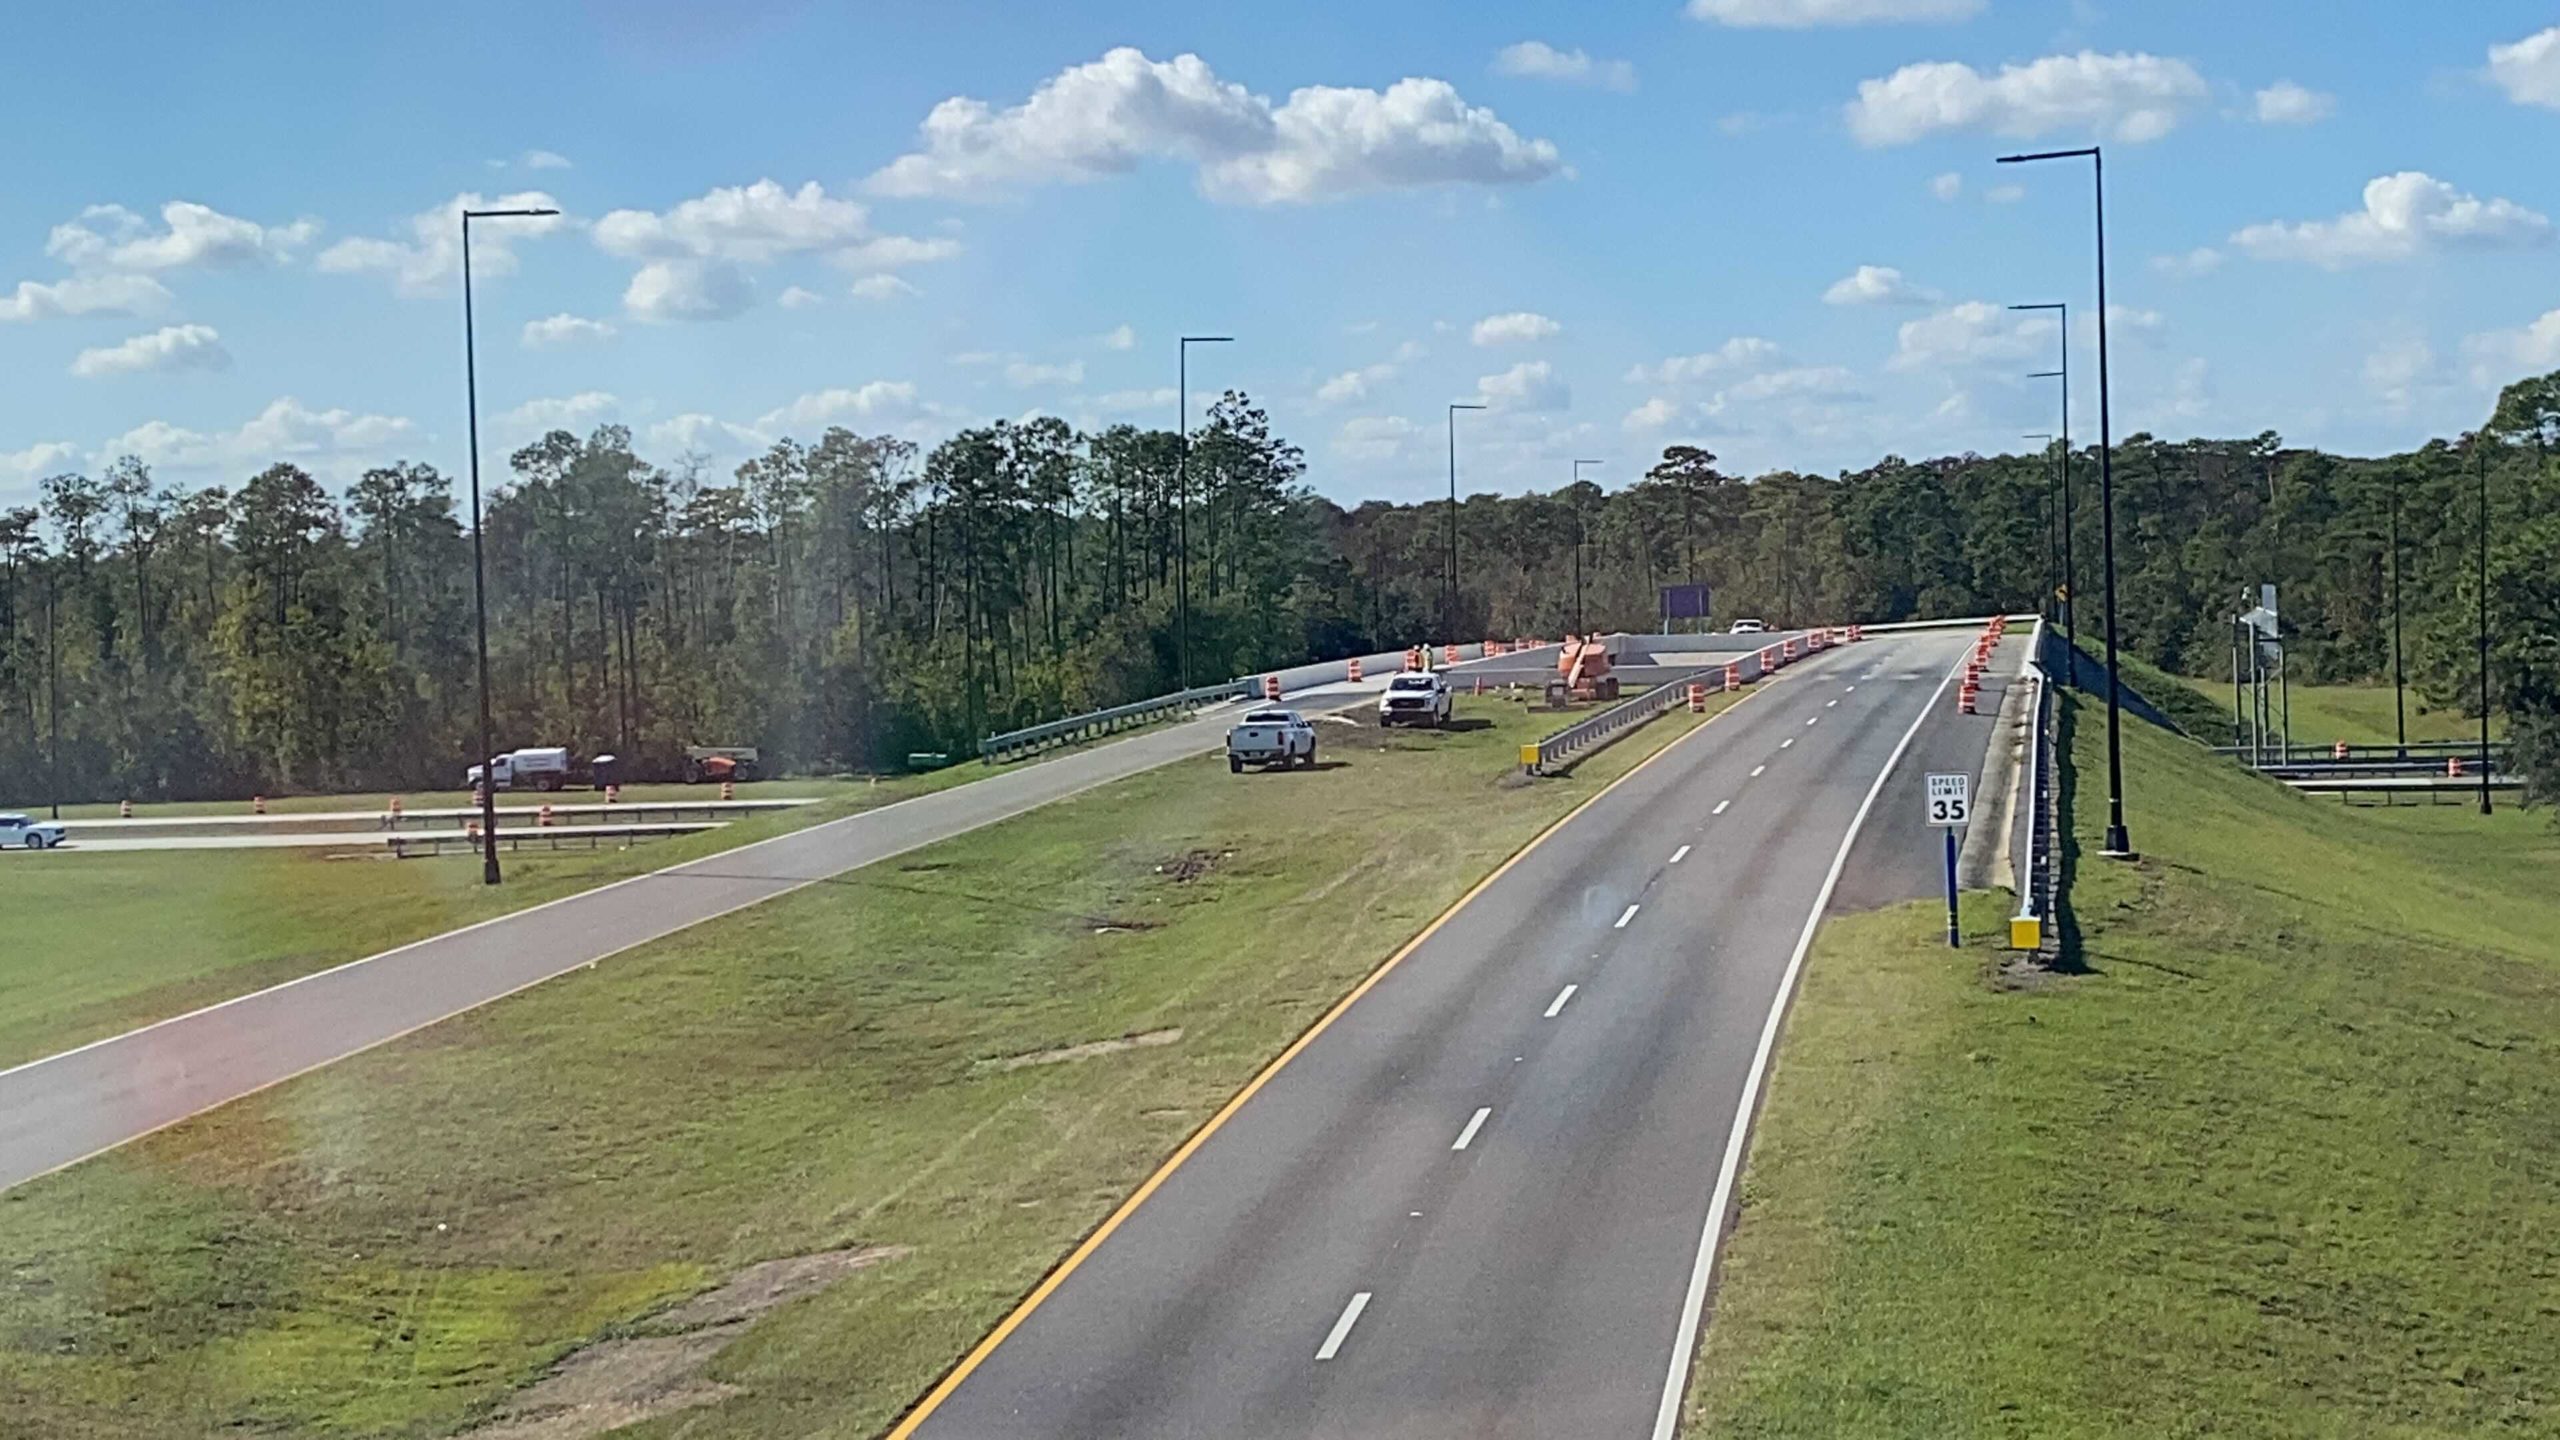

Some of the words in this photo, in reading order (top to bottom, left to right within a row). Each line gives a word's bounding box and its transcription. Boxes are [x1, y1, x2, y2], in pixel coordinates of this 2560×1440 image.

[1932, 777, 1965, 786] SPEED
[1932, 787, 1964, 796] LIMIT
[1933, 800, 1965, 820] 35
